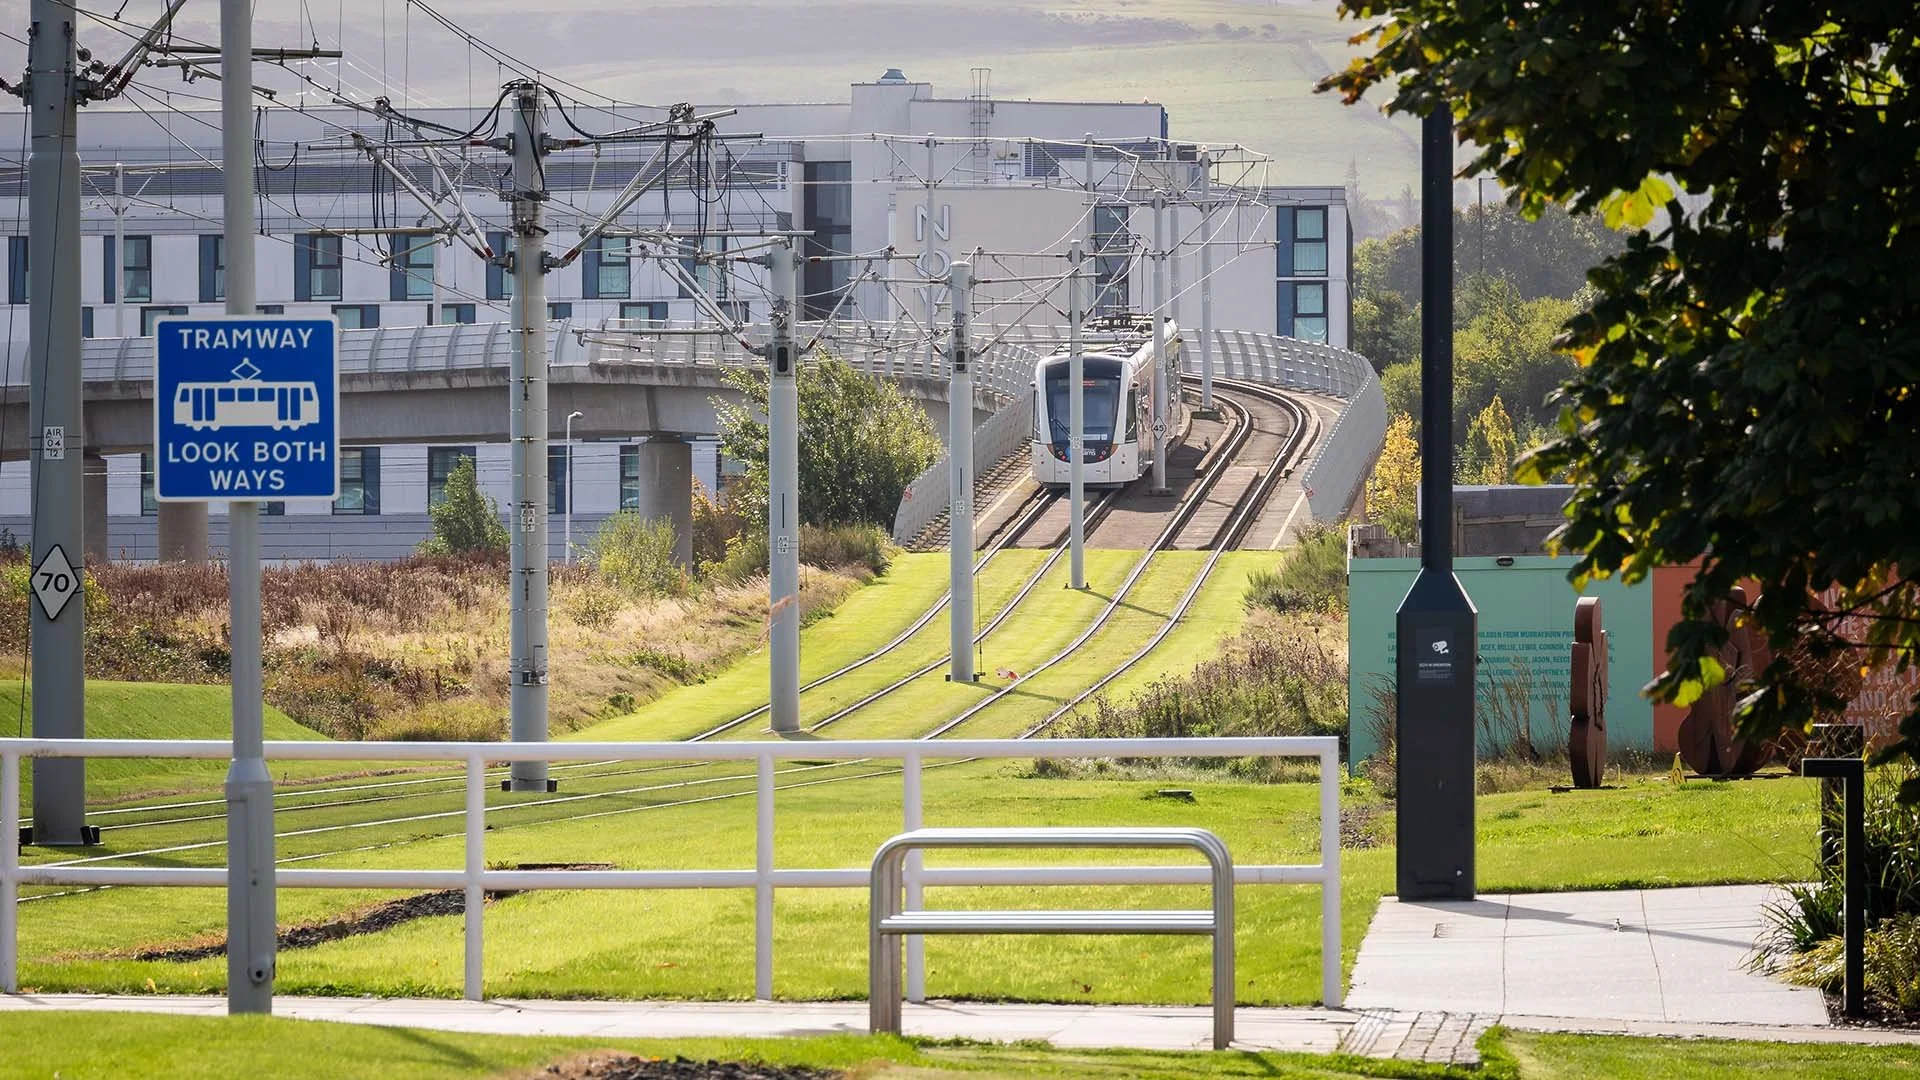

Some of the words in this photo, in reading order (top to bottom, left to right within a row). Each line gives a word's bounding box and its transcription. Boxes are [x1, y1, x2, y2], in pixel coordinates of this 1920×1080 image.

[178, 328, 313, 350] TRAMWAY
[46, 428, 62, 436] AIR
[47, 439, 61, 447] 04
[167, 441, 240, 463] LOOK
[253, 441, 326, 462] BOTH
[209, 469, 285, 491] WAYS
[39, 572, 70, 594] 70
